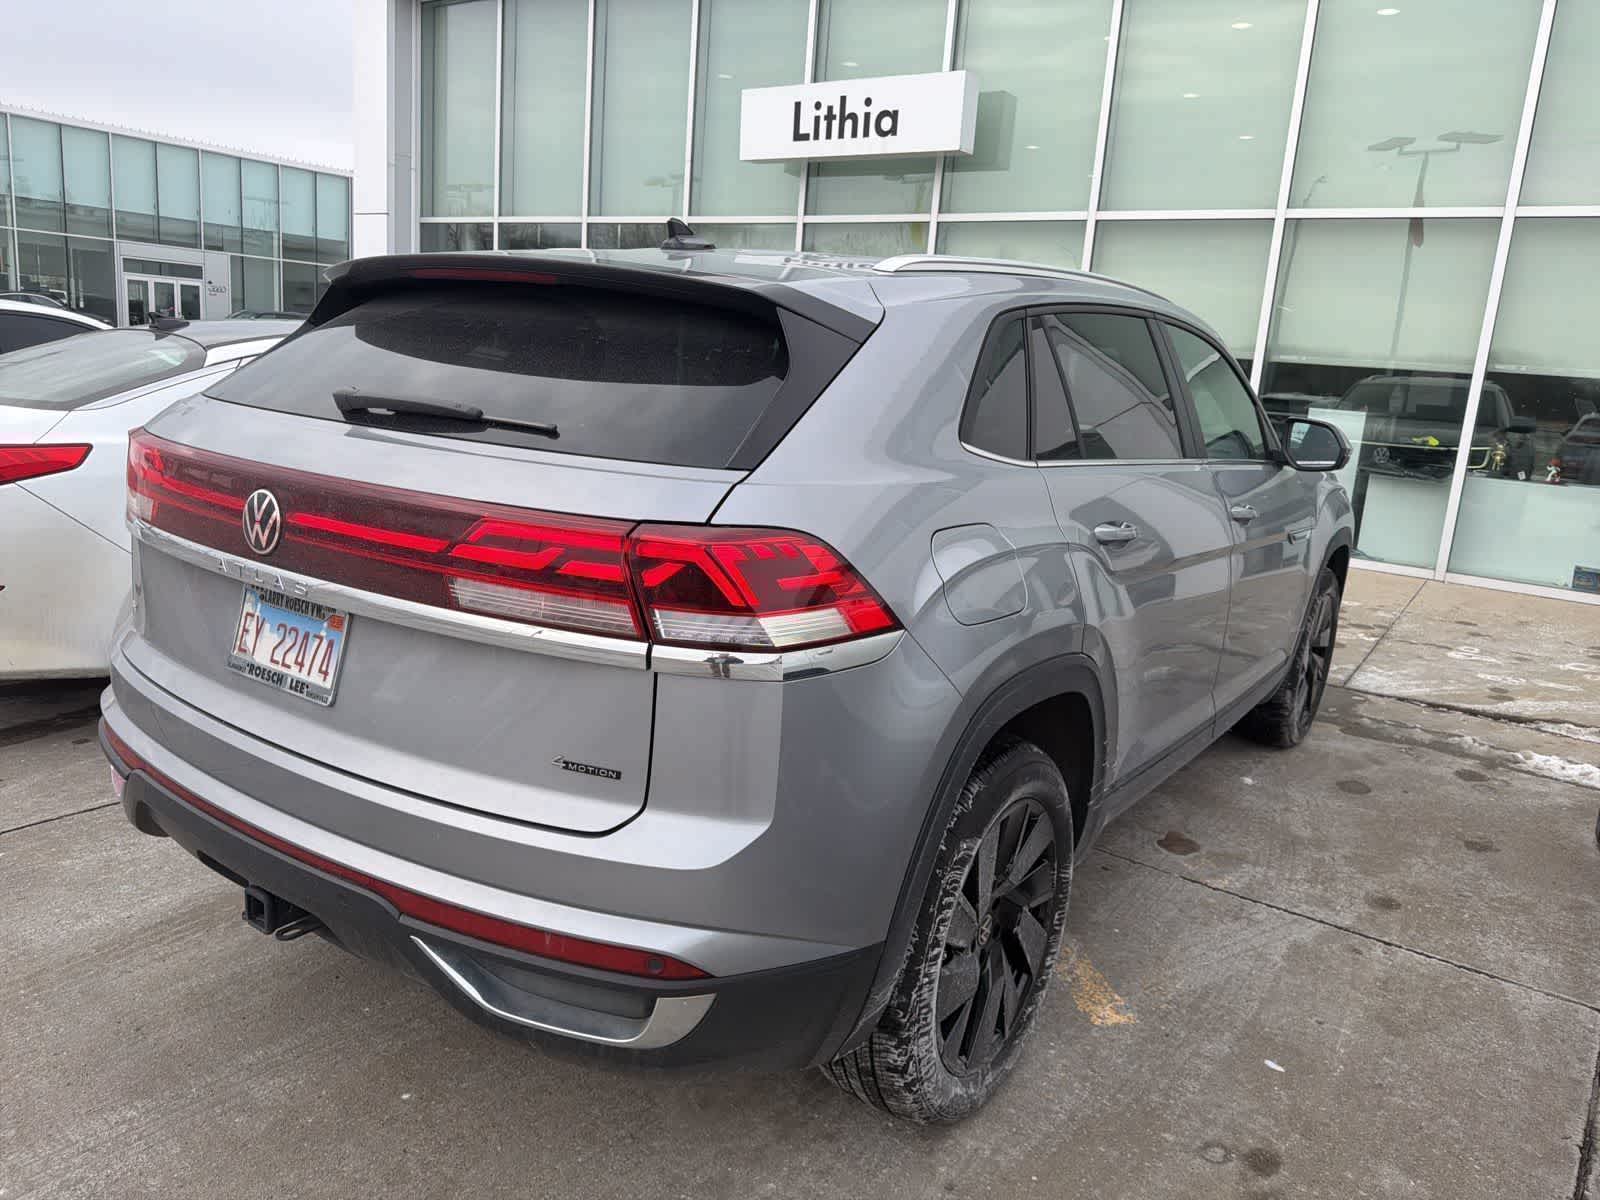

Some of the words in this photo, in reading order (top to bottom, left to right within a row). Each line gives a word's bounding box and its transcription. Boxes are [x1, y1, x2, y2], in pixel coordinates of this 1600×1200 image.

[792, 95, 899, 142] Lithia
[243, 489, 280, 554] VW
[217, 557, 308, 598] ATLAS
[264, 587, 284, 608] LARRY
[285, 595, 310, 615] ROESCH
[237, 611, 266, 656] EY
[269, 623, 335, 682] 22474
[552, 755, 618, 779] 4MOTION
